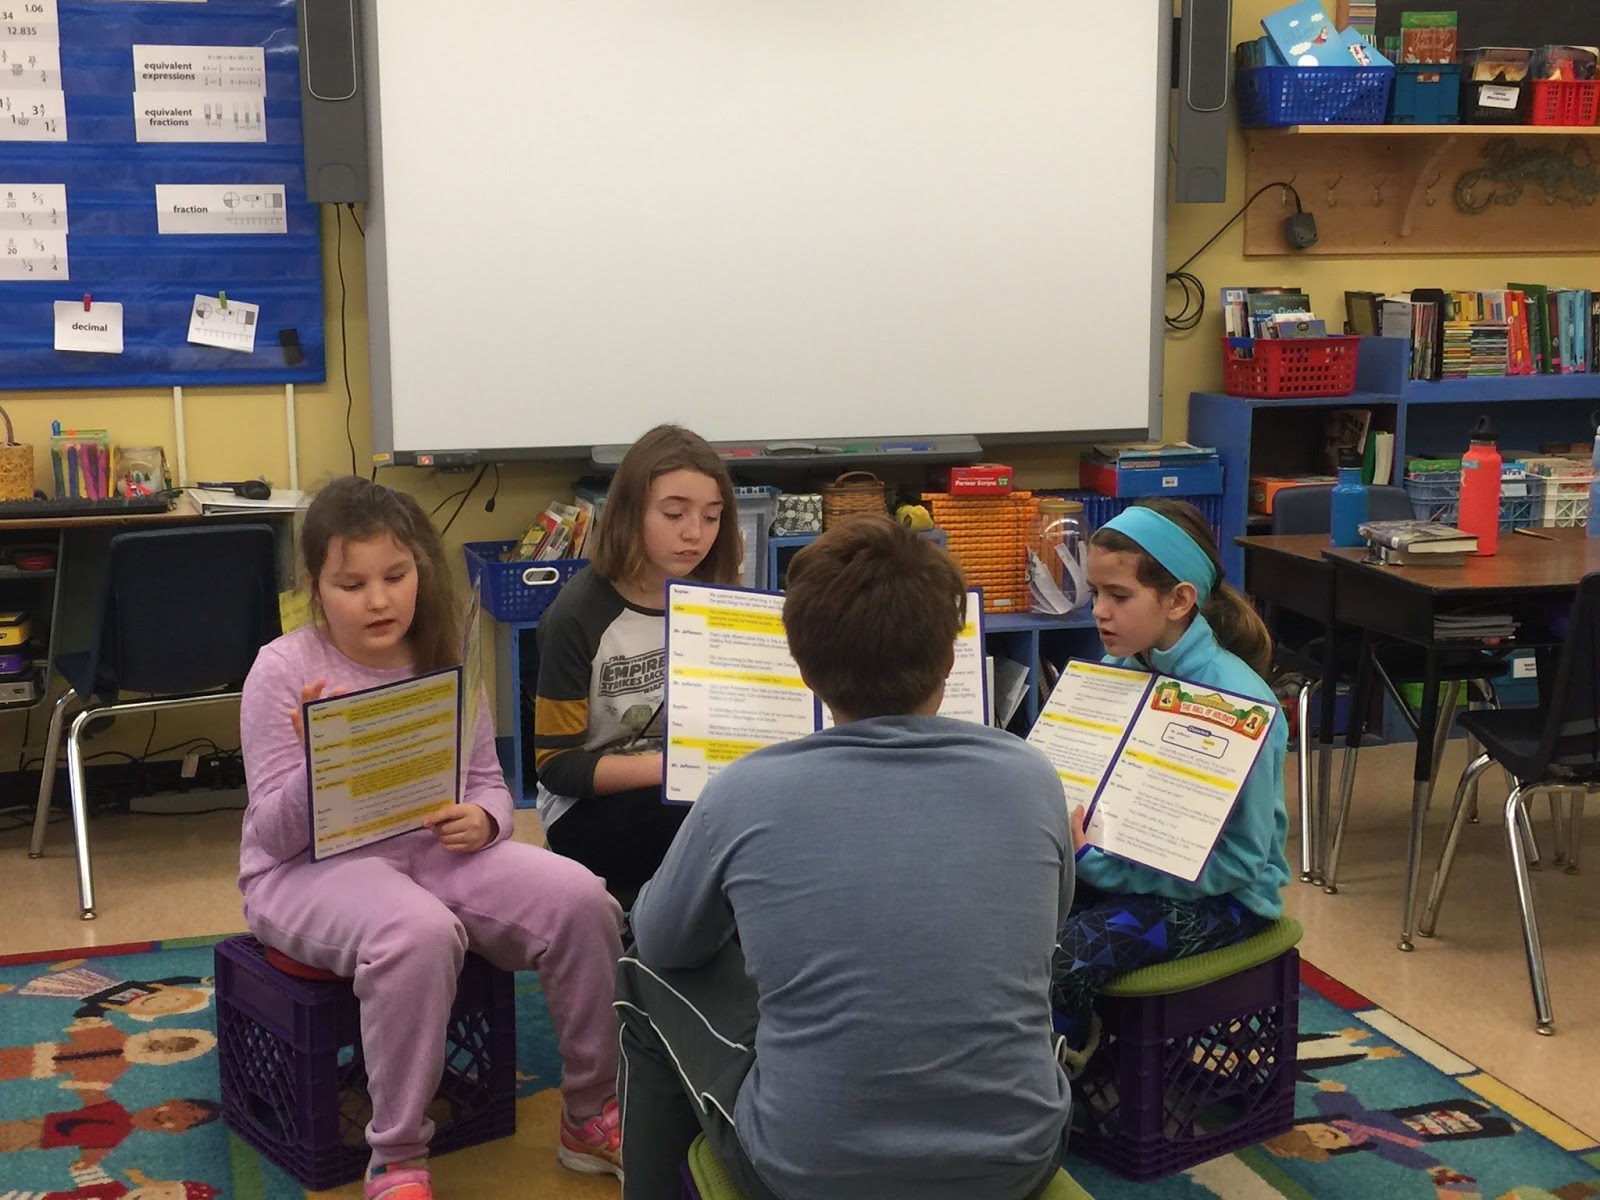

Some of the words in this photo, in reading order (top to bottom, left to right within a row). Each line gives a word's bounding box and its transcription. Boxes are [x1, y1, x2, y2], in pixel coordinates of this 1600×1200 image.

[8, 27, 37, 35] 12.835
[144, 62, 192, 70] equivalent
[142, 72, 196, 81] expressions
[144, 109, 192, 118] equivalent
[149, 118, 189, 126] fractions
[173, 205, 208, 214] fraction
[72, 322, 108, 333] decimal
[601, 676, 642, 690] STRIKES
